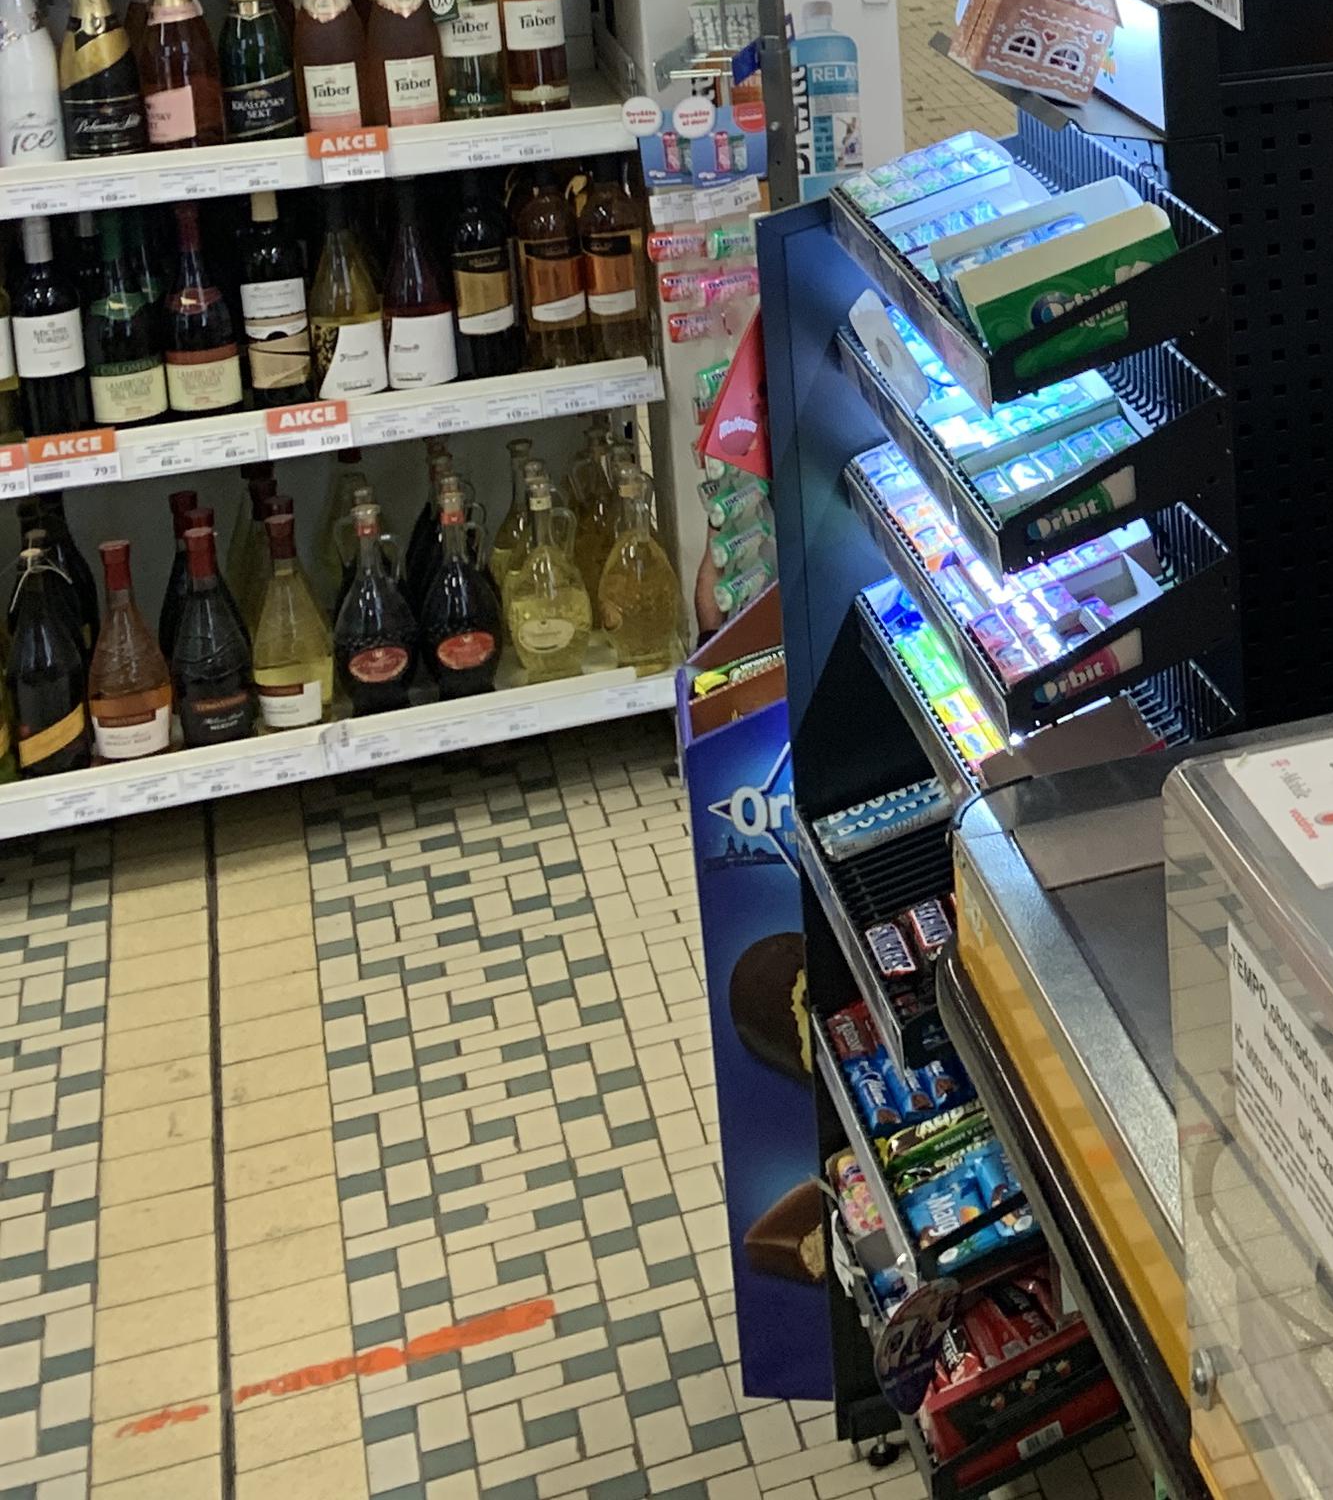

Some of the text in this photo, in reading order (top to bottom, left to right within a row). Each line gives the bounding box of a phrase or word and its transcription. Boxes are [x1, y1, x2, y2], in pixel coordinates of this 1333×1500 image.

[452, 20, 489, 35] Faber
[519, 14, 556, 29] Faber
[312, 85, 351, 99] Faber
[394, 77, 432, 92] Faber
[320, 133, 377, 153] AKCE
[279, 406, 337, 429] AKCE
[41, 436, 102, 458] AKCE
[94, 466, 108, 476] 79
[1268, 1004, 1319, 1085] obchodní
